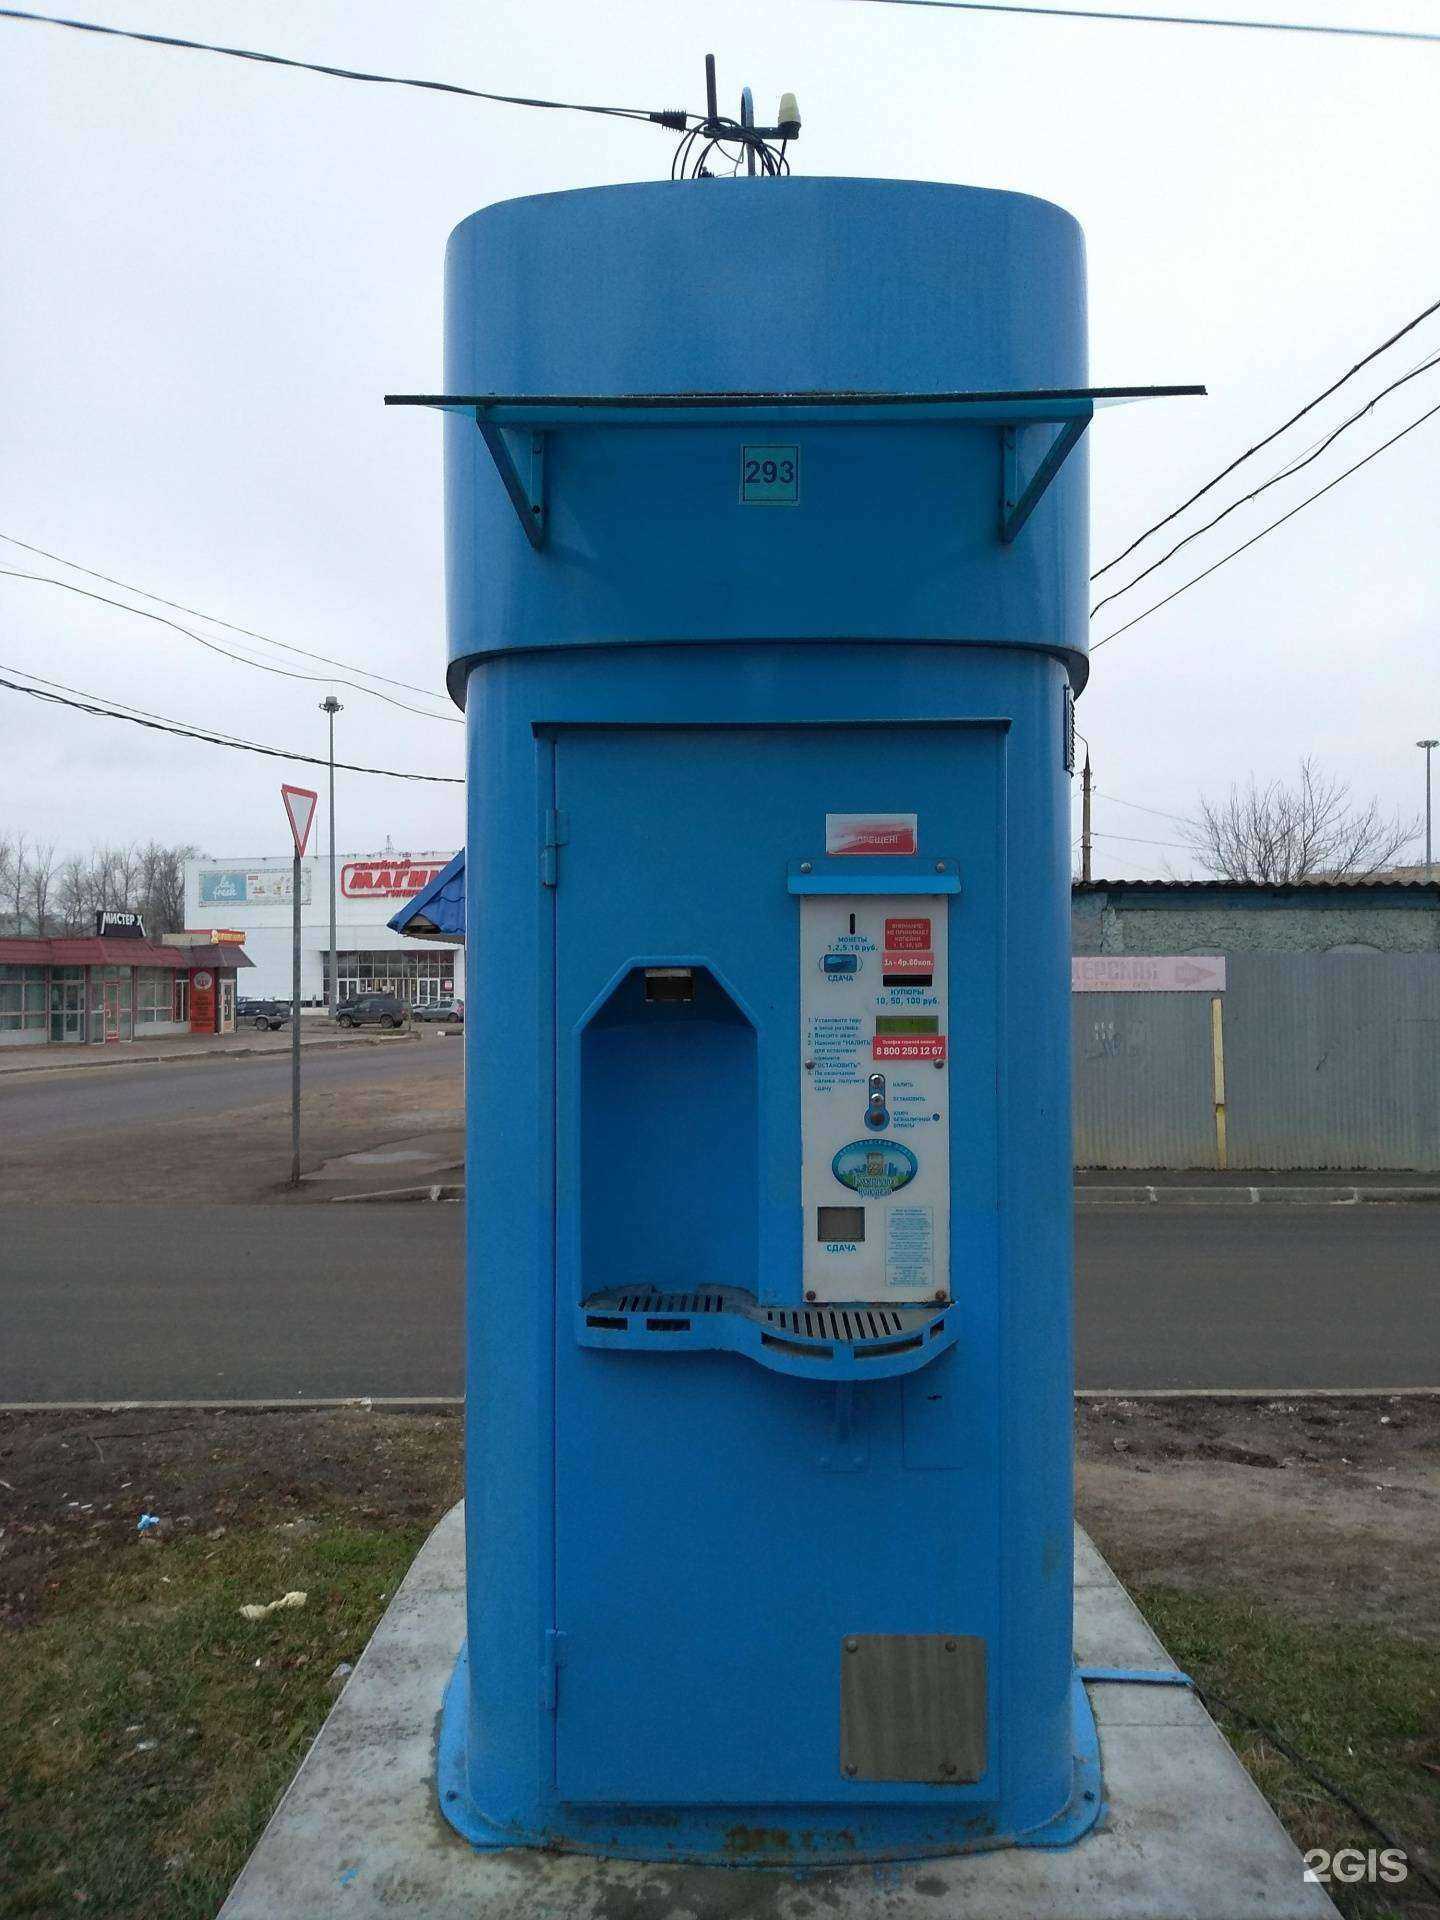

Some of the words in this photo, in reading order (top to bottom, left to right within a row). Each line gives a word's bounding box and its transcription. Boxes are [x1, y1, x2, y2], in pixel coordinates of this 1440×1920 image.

[746, 460, 793, 483] 293
[349, 870, 441, 889] МАГН
[101, 912, 135, 934] МИСТЕР
[922, 997, 939, 1006] руб.
[876, 1047, 881, 1055] 8
[884, 1047, 900, 1055] 800
[902, 1047, 918, 1055] 250
[920, 1047, 930, 1055] 12
[932, 1047, 943, 1055] 67
[826, 1243, 857, 1253] СДАЧА
